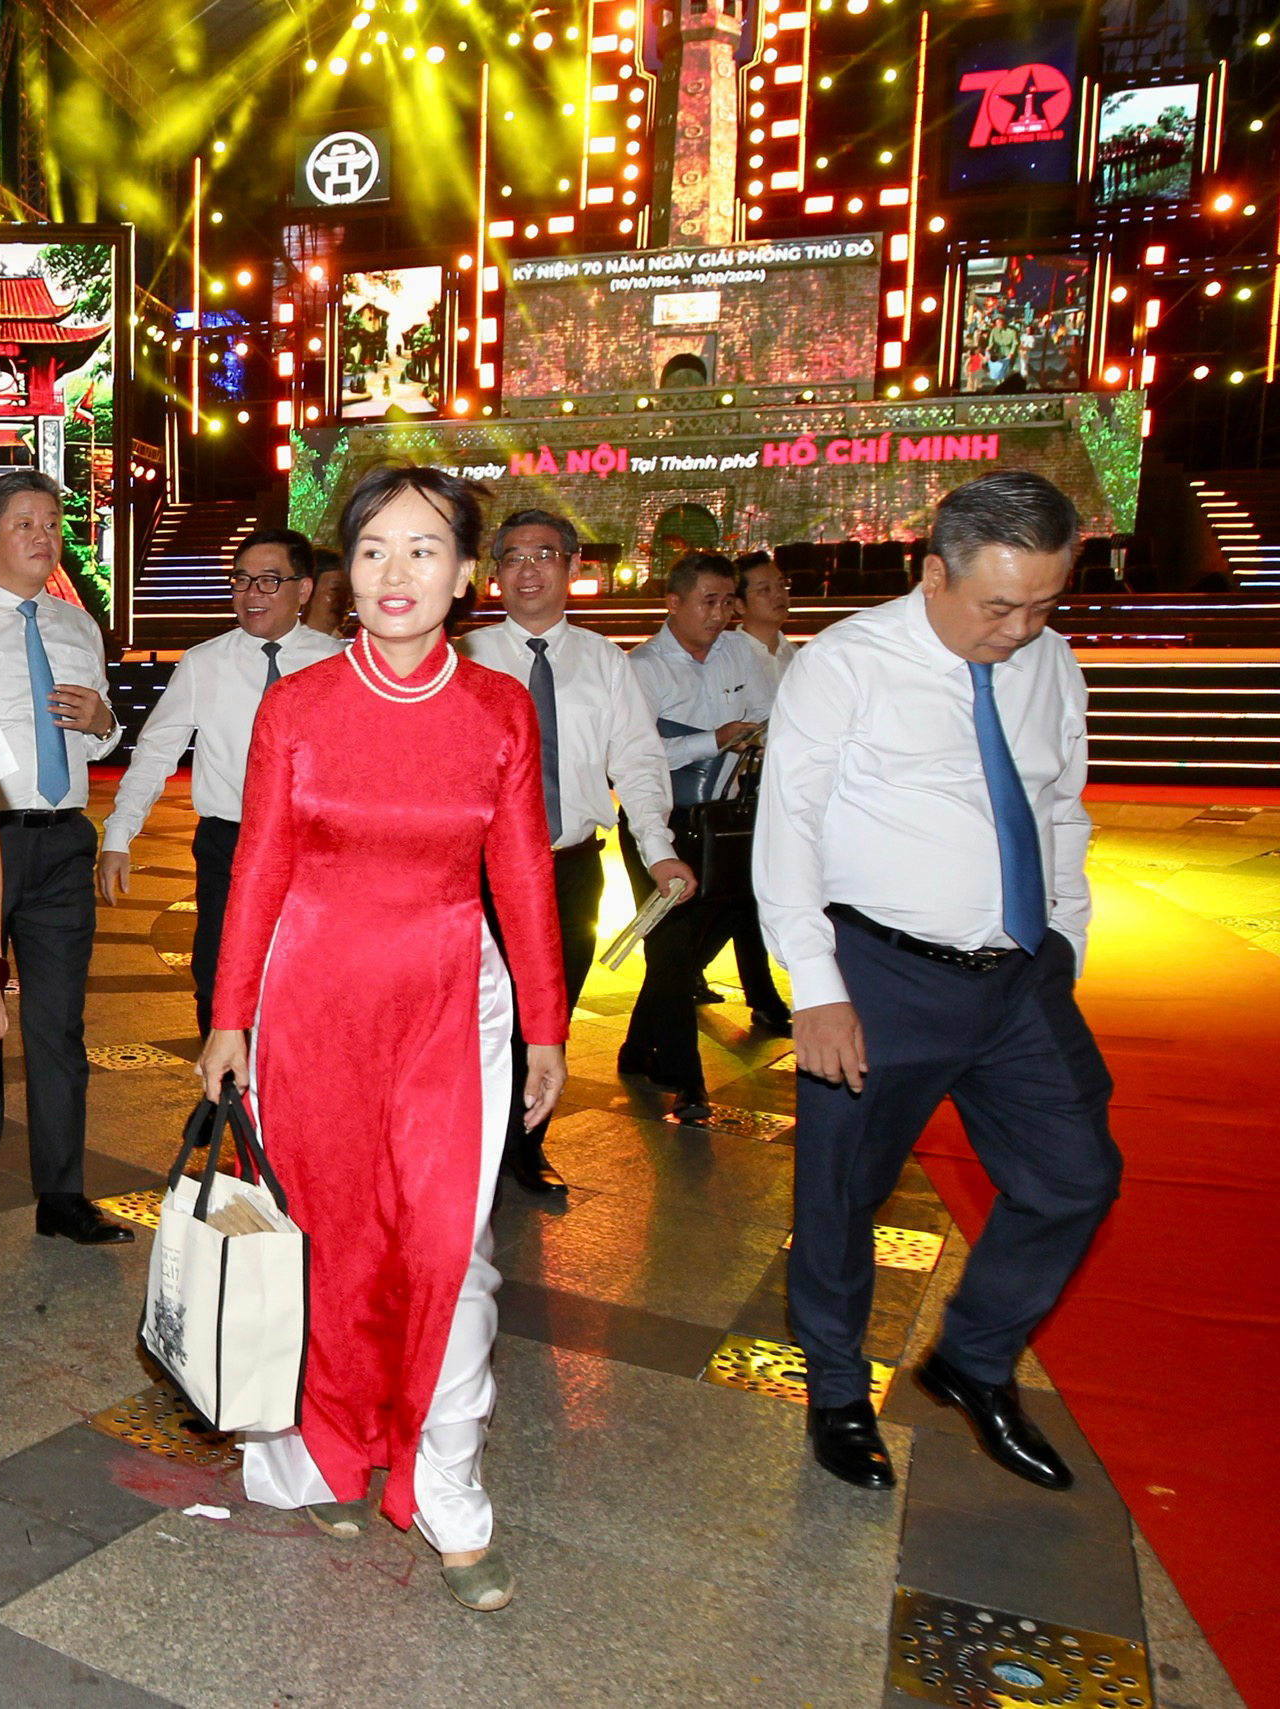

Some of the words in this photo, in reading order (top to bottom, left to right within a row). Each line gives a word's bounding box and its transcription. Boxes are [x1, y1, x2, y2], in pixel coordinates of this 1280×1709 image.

[581, 261, 603, 276] 70
[606, 256, 645, 274] NĂM
[844, 239, 874, 257] ĐÔ
[509, 444, 560, 476] HÀ
[567, 442, 628, 479] NỘI
[630, 456, 657, 475] Tại
[660, 454, 718, 472] Thành
[720, 450, 759, 472] phố
[825, 431, 894, 465] CHÍ
[898, 434, 999, 463] MINH
